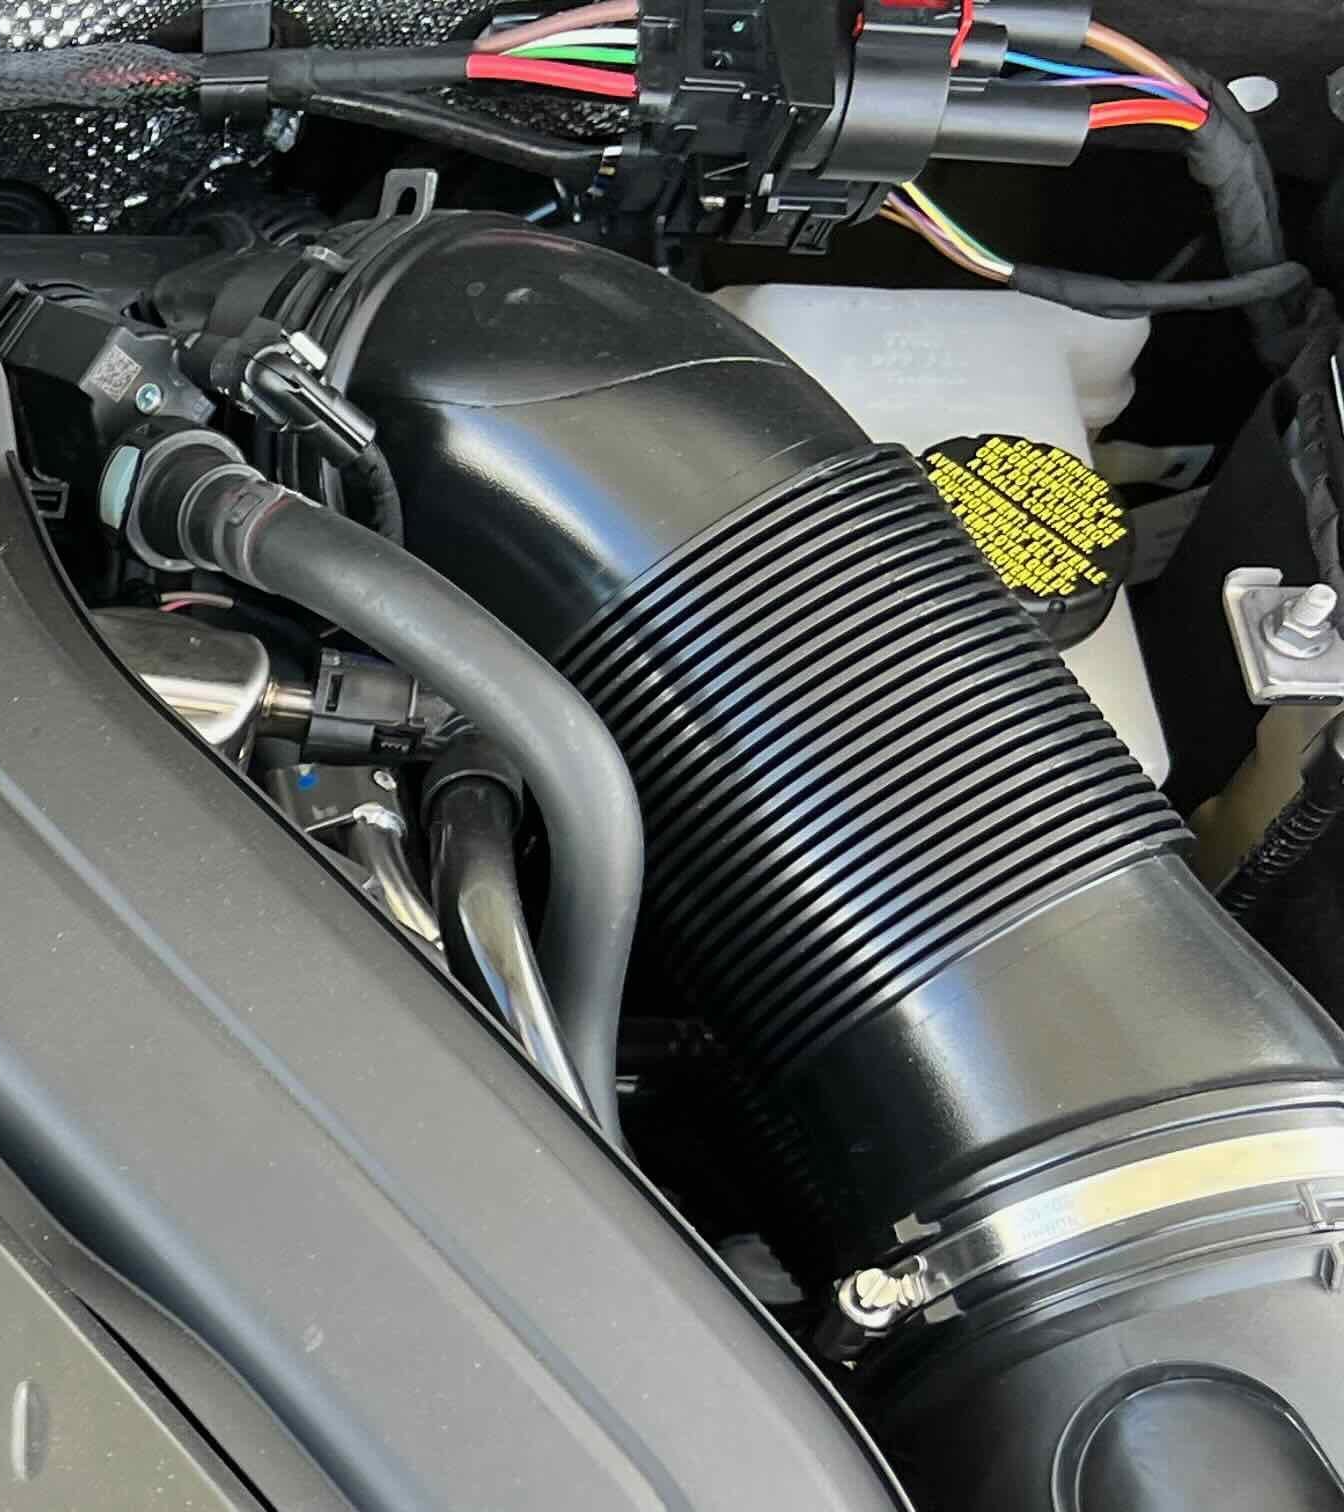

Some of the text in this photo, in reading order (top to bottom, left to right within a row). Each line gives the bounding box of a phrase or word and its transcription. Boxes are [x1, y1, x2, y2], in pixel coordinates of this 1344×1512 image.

[966, 458, 983, 471] A
[977, 464, 1028, 502] SEALED
[975, 446, 1013, 475] ONLY
[1006, 469, 1038, 492] DOT
[1039, 489, 1080, 523] FLUID
[1074, 517, 1116, 549] FROM
[985, 437, 1040, 476] BEFORE
[1097, 516, 1127, 541] USE
[1013, 440, 1123, 519] CLEAN FILLER CAP
[1047, 447, 1109, 496] WARNING:
[928, 469, 991, 516] BOUCHON
[983, 511, 1031, 545] AVANT
[1025, 541, 1050, 559] DE
[1023, 521, 1092, 574] NETTOYER
[1083, 566, 1108, 585] LE
[1025, 559, 1058, 583] QUE
[1049, 577, 1076, 596] DU
